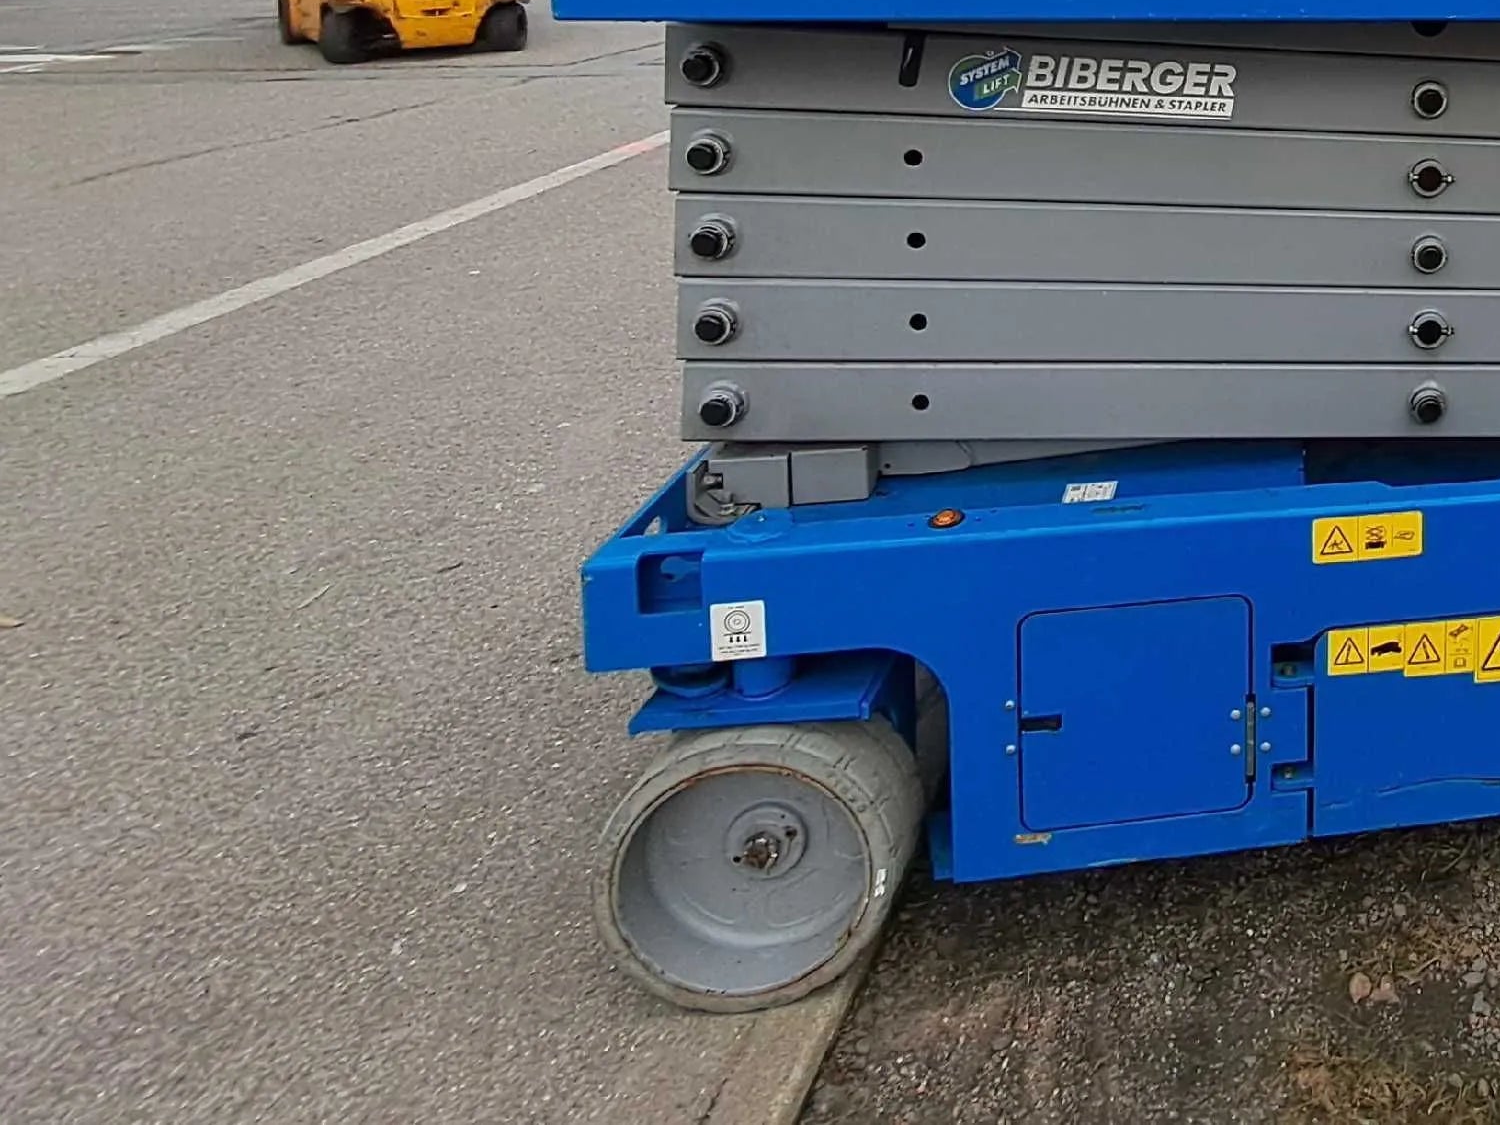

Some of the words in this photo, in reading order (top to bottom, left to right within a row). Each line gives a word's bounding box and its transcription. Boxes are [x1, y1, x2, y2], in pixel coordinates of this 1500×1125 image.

[959, 55, 1010, 86] SYSTEM
[1026, 55, 1237, 96] BIBERGER
[983, 74, 1010, 94] LIFT
[1028, 93, 1151, 109] ARBEITSBÜHNEN
[1155, 98, 1164, 109] &
[1168, 98, 1227, 113] STAPLER
